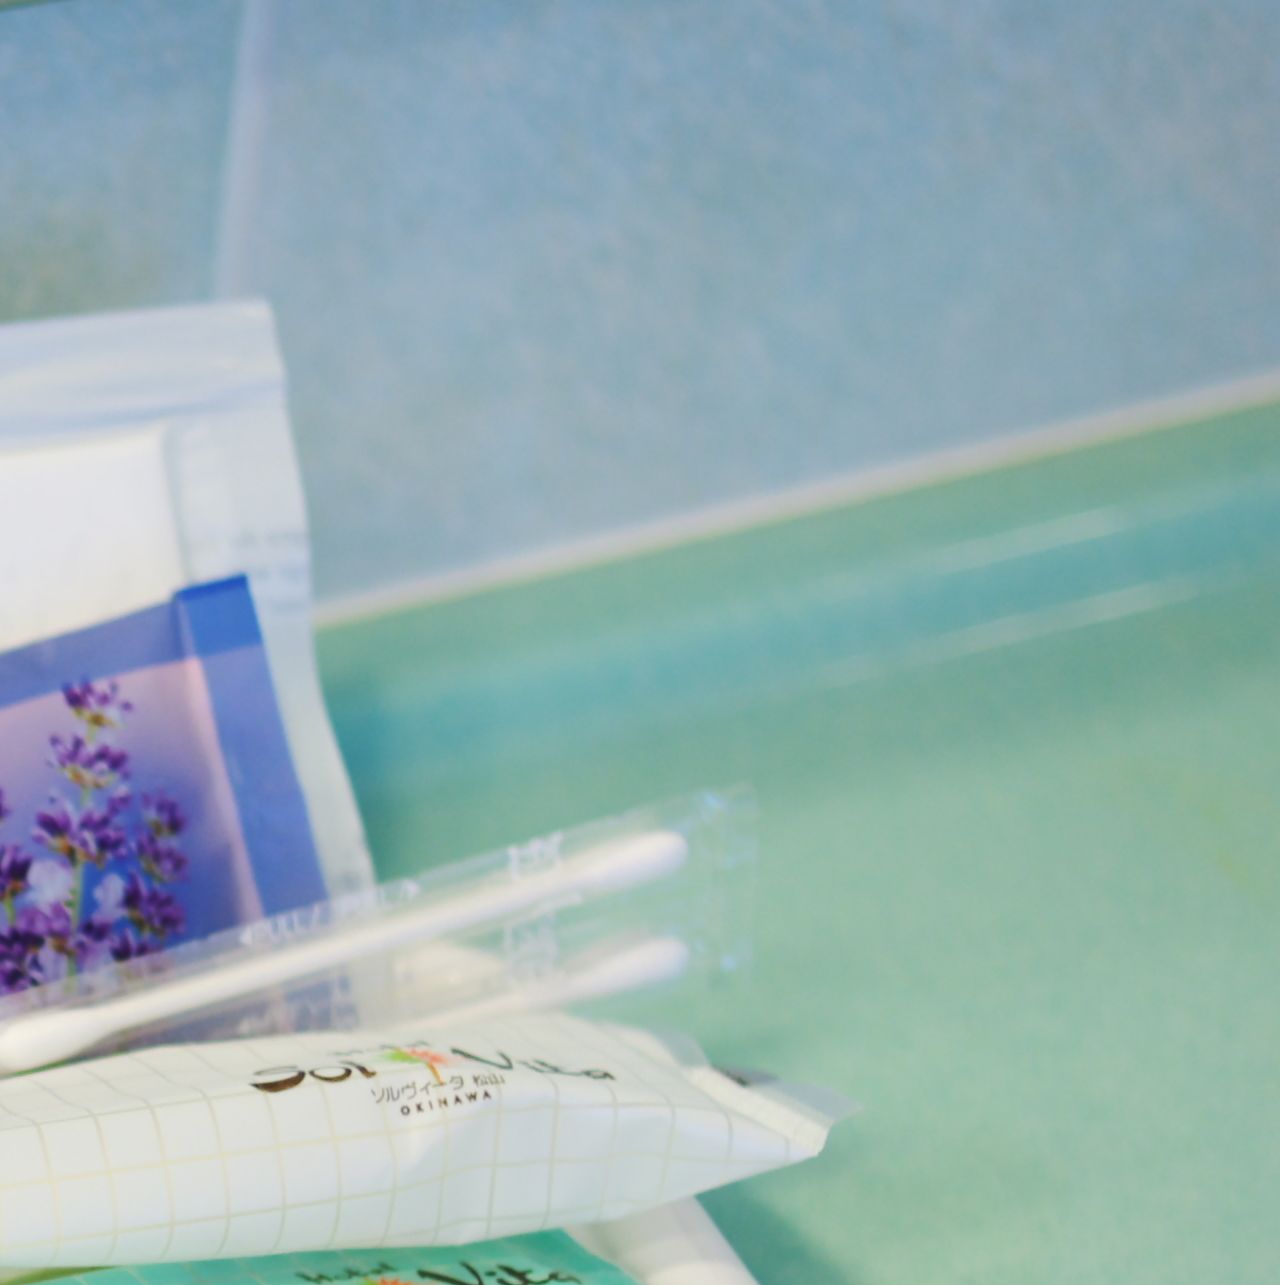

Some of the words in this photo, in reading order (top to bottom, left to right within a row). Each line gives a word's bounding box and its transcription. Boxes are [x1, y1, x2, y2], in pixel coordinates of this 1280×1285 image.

[248, 1060, 378, 1093] Sol
[450, 1047, 618, 1081] Vita
[400, 1090, 493, 1116] OKINAWA
